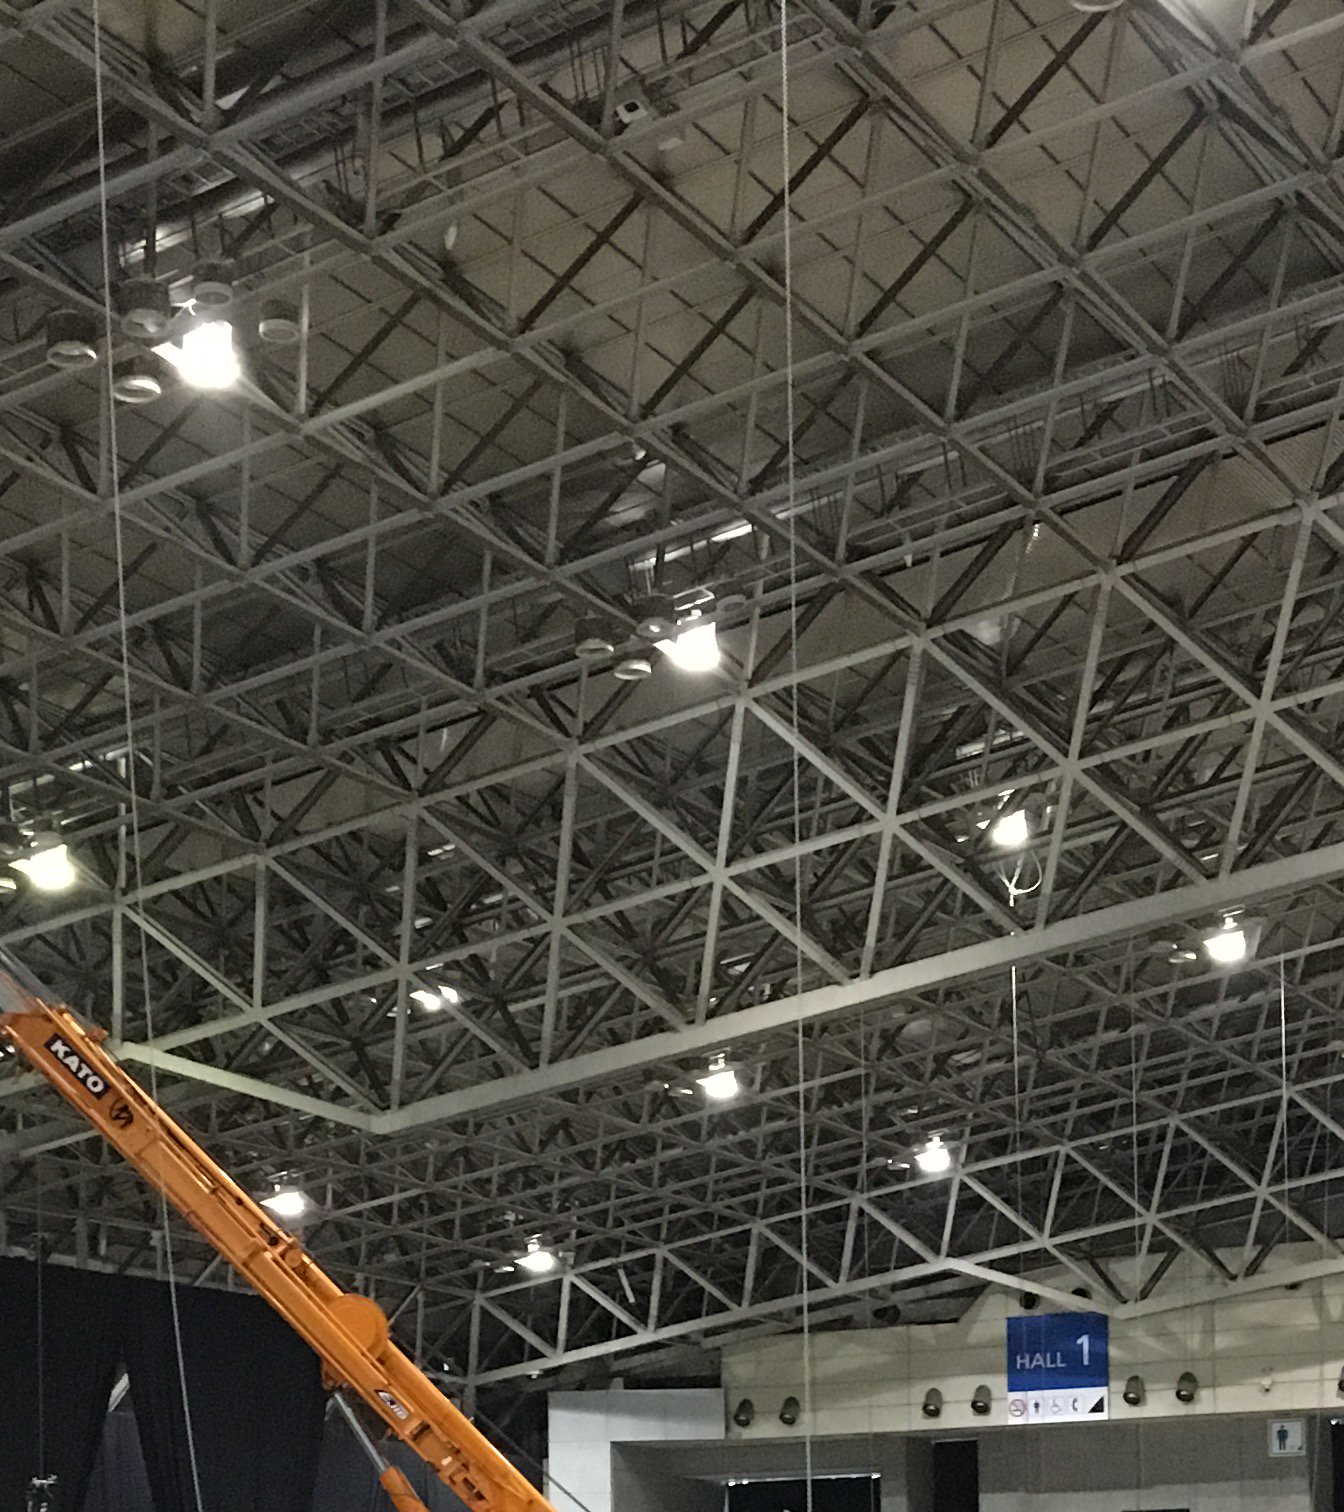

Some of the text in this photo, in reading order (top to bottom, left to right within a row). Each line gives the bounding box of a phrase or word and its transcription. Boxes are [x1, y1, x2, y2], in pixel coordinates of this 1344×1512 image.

[50, 1039, 105, 1093] KATO
[1016, 1334, 1090, 1370] HALL 1
